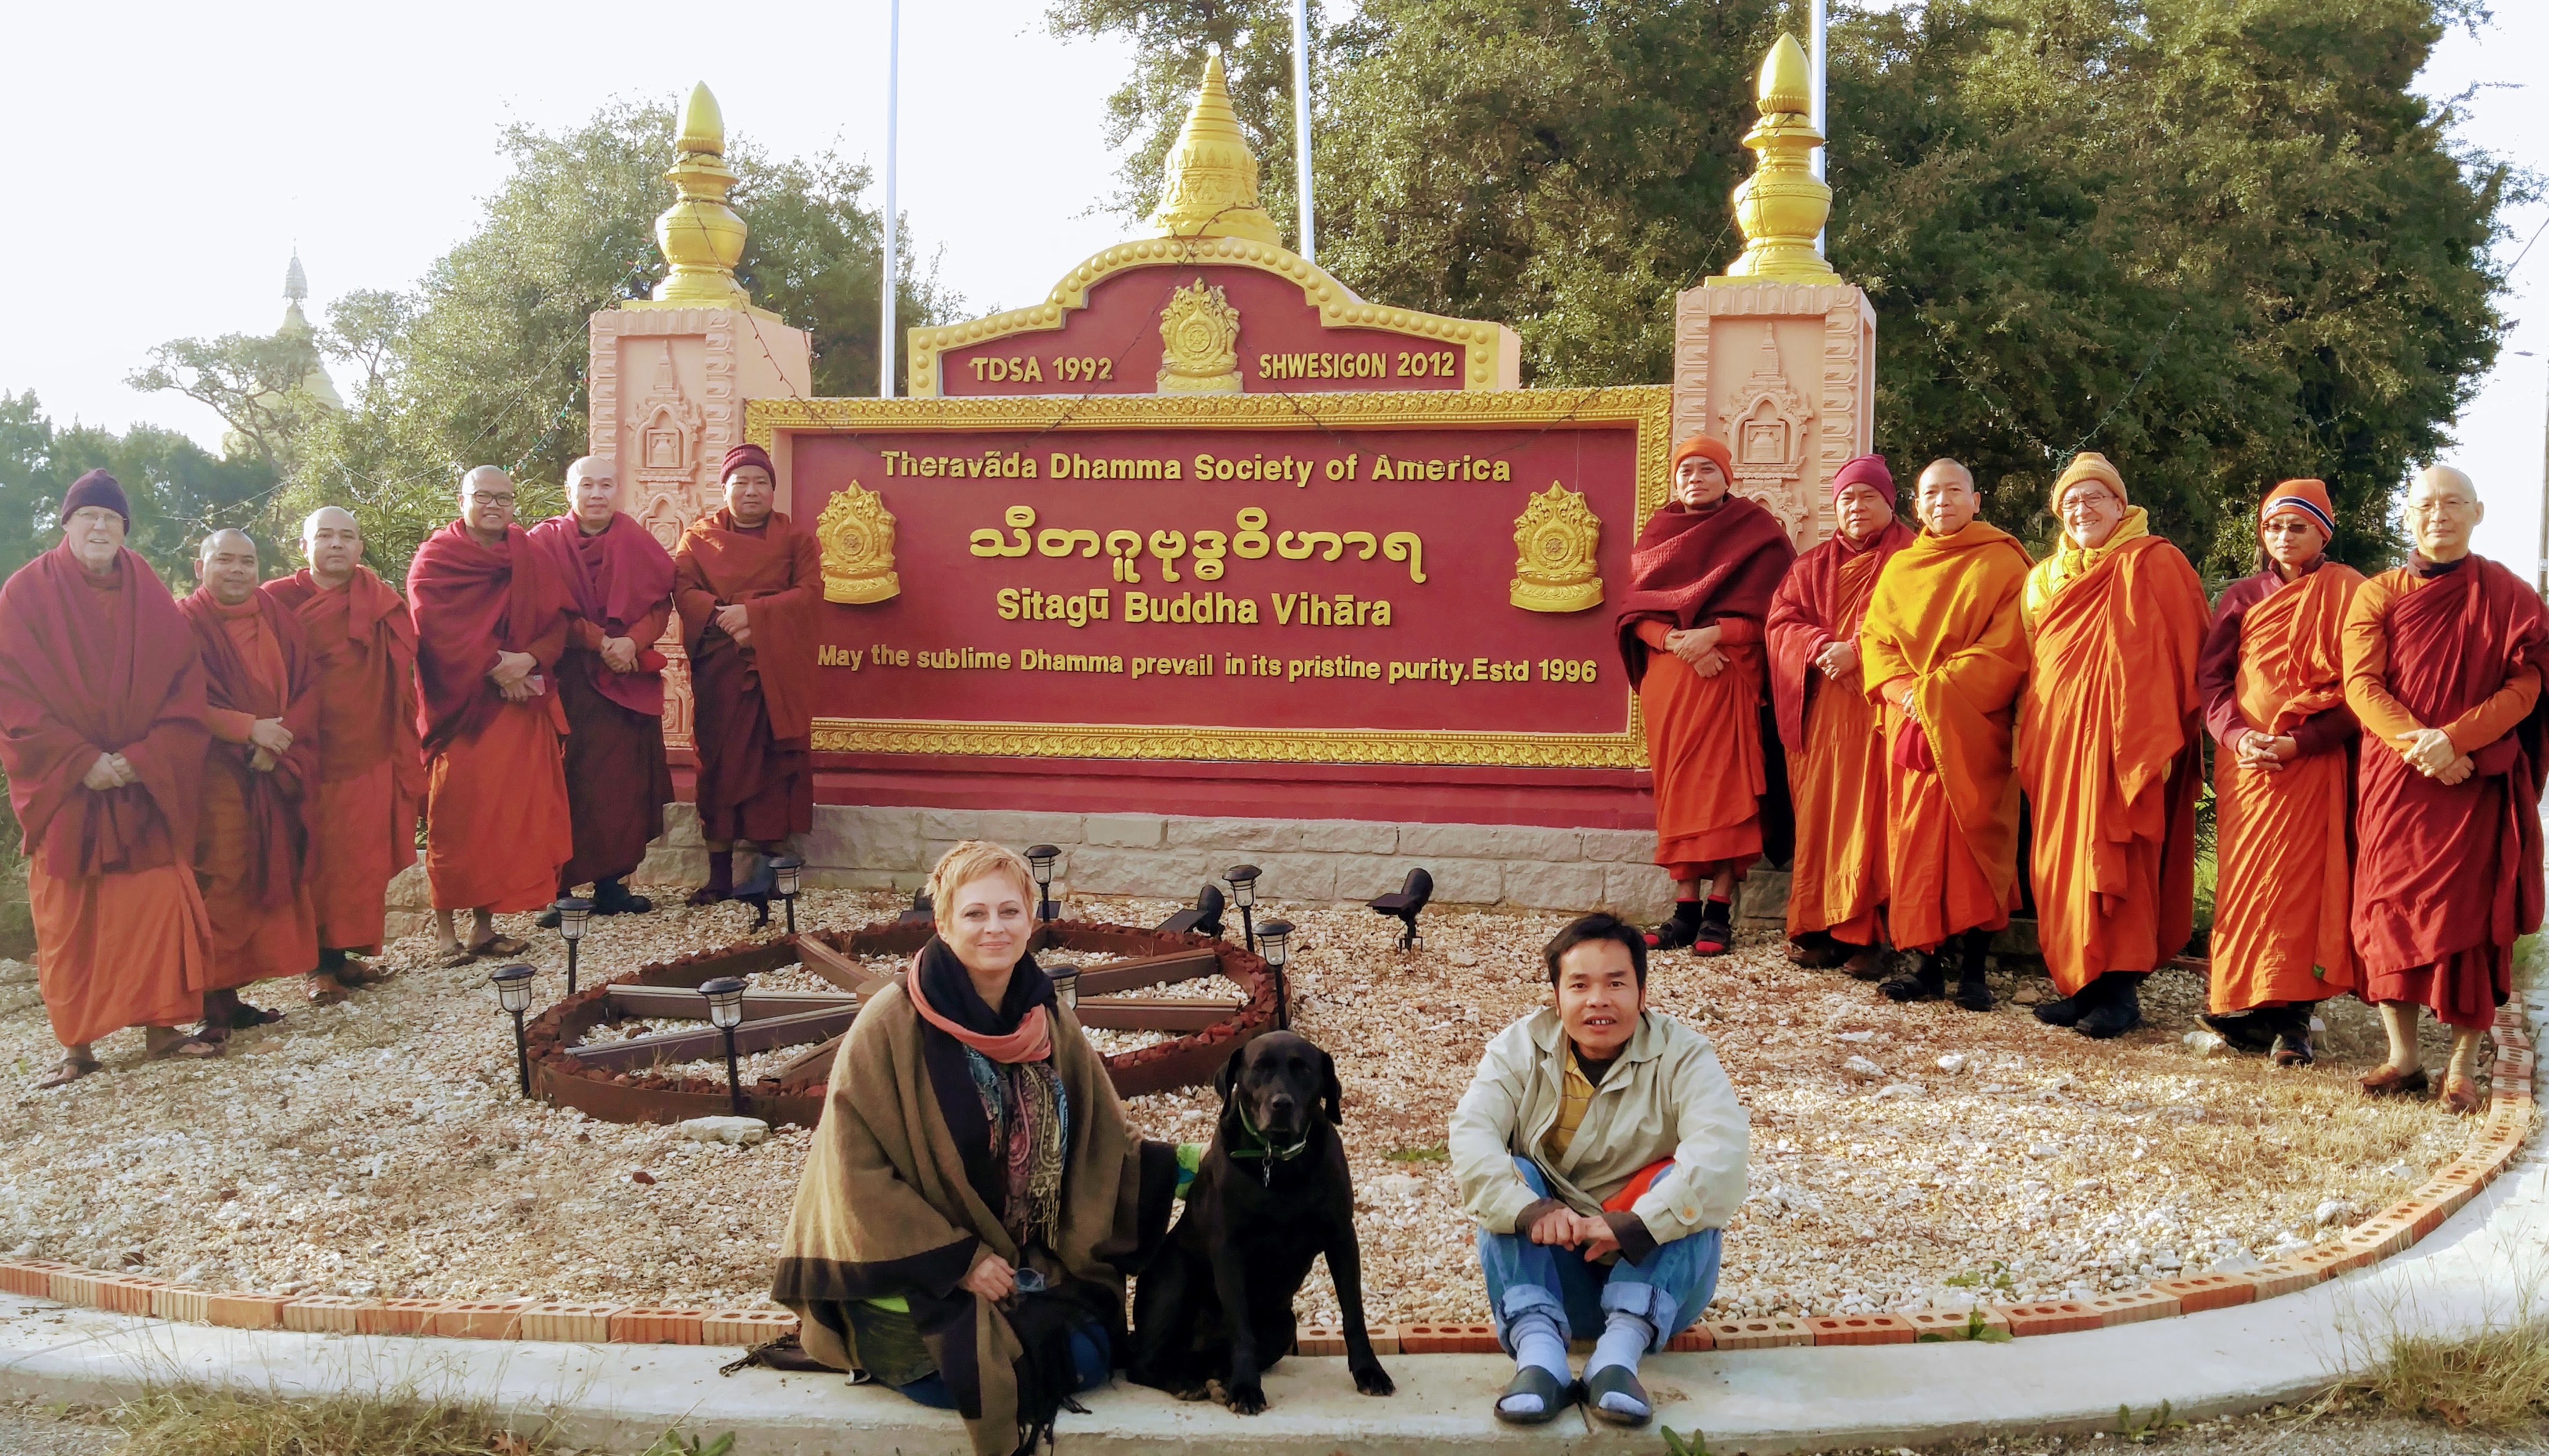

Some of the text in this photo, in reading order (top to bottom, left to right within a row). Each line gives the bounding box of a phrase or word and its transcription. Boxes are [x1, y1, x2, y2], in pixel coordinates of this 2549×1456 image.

[965, 356, 1113, 383] TDSA 1992
[1258, 351, 1455, 379] SHWESIGON 2012
[880, 450, 1510, 488] Theravāda Dhamma Society of America
[996, 587, 1392, 627] Sitagū Buddha Vihāra
[817, 645, 863, 671] May
[871, 644, 909, 666] the
[917, 647, 1011, 670] sublime
[1021, 648, 1124, 673] Dhamma
[1132, 654, 1213, 679] prevail
[1225, 652, 1246, 675] in
[1252, 654, 1281, 676] its
[1288, 654, 1381, 682] pristine
[1538, 659, 1597, 682] 1996
